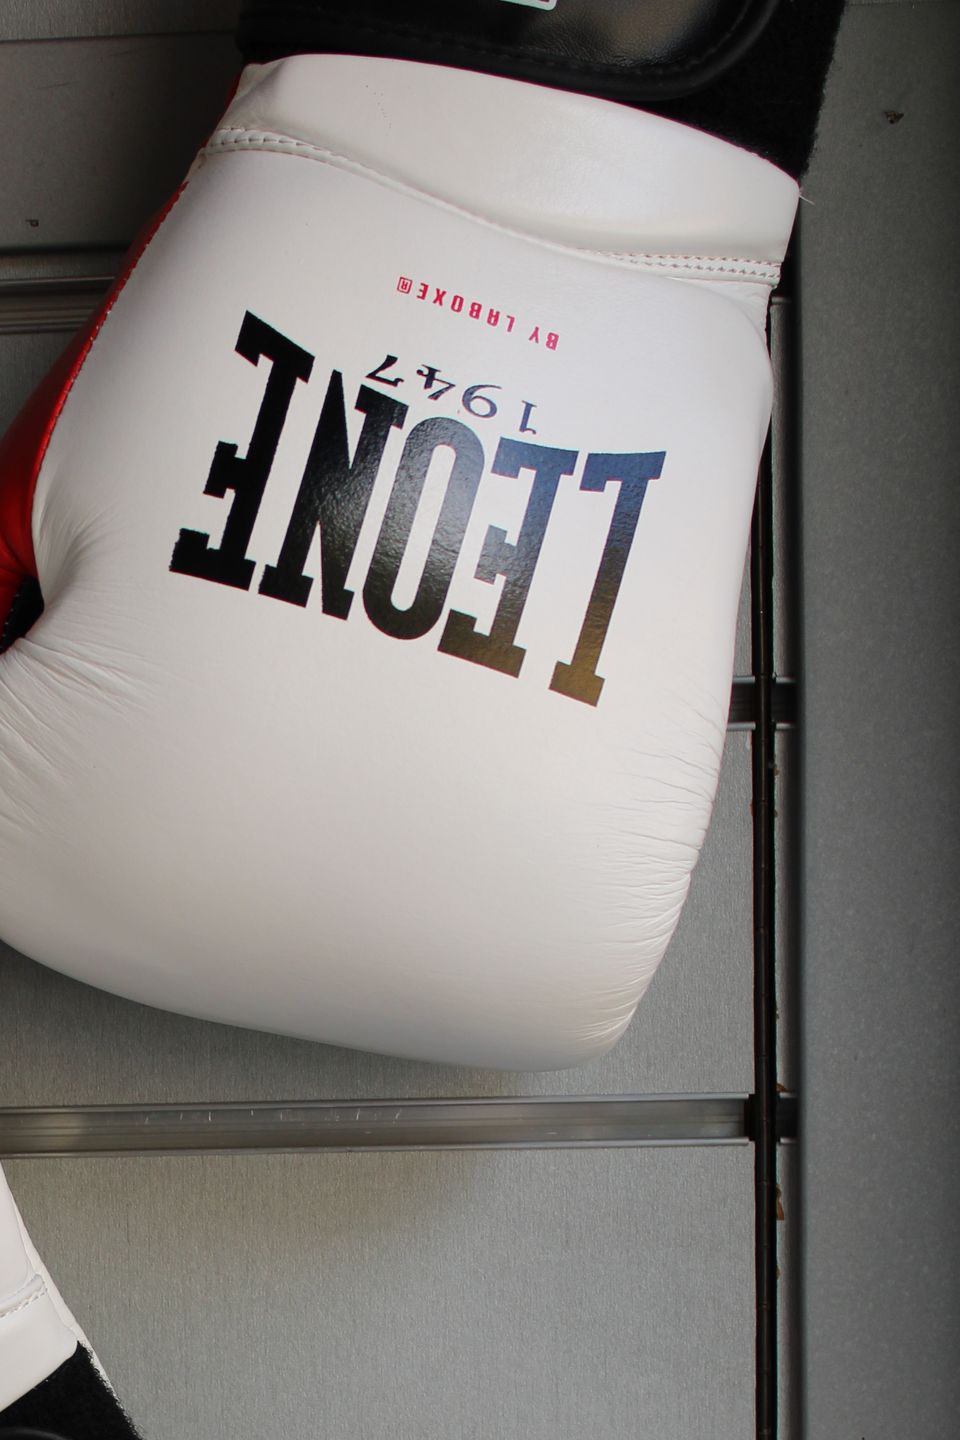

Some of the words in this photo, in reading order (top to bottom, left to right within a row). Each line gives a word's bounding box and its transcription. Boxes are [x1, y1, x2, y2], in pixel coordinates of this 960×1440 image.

[528, 326, 559, 351] BY
[365, 354, 538, 435] 1947
[169, 310, 667, 708] LEONE
